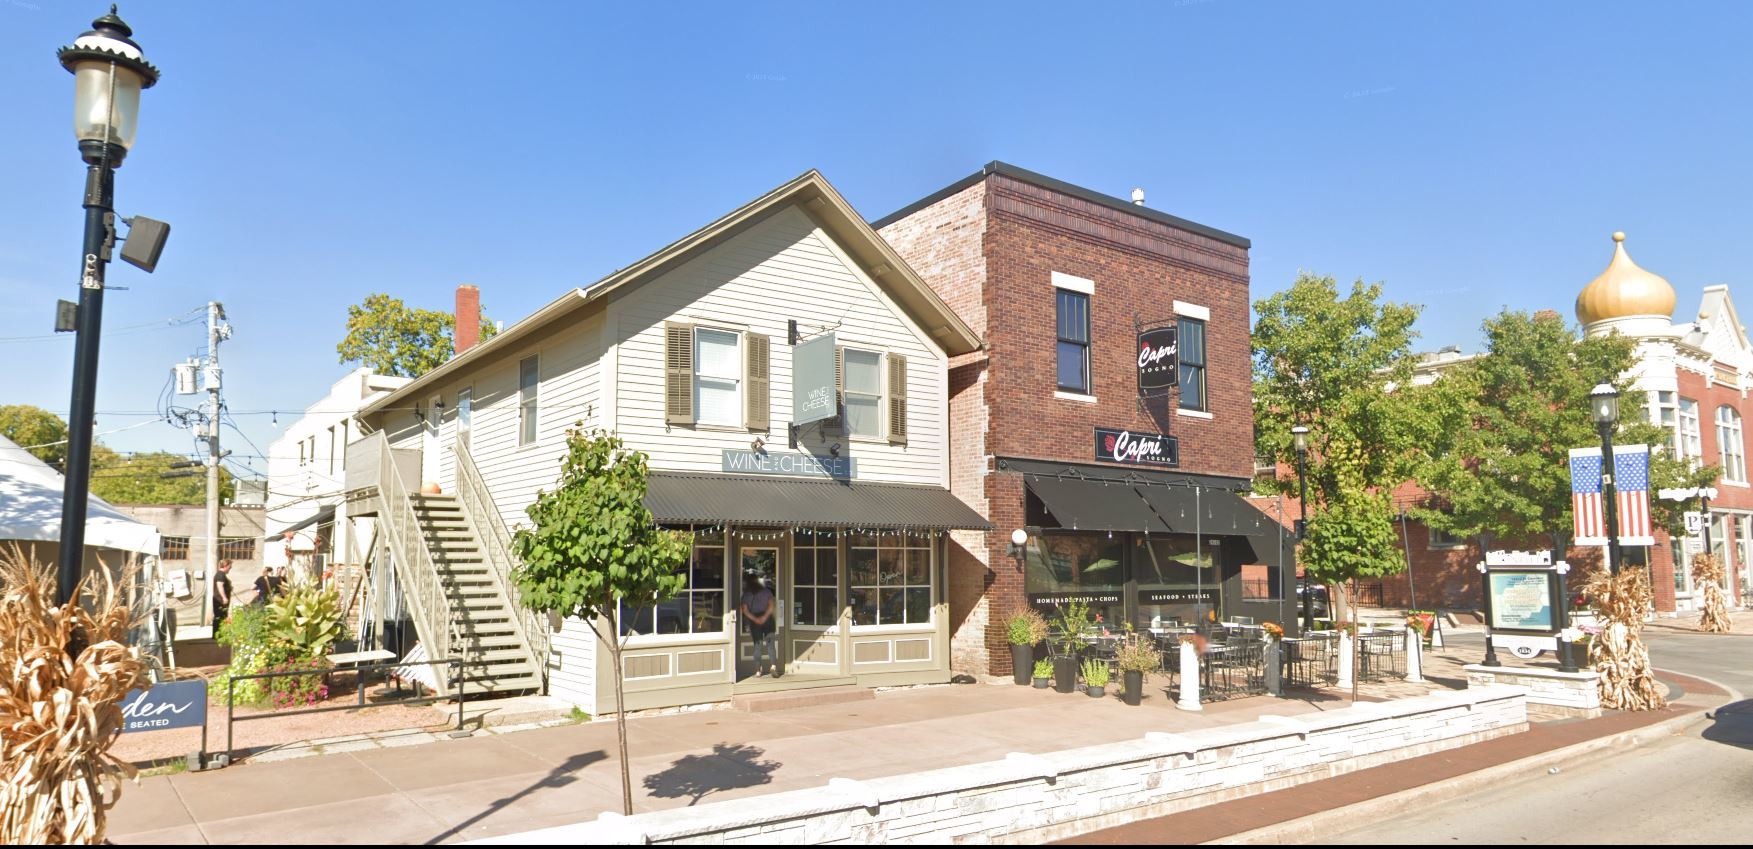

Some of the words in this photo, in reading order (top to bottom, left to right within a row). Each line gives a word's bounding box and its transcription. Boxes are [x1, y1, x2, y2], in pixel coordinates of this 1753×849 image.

[1138, 340, 1176, 367] Capri
[1141, 364, 1174, 373] SOGNO
[807, 386, 827, 400] WINE
[802, 395, 829, 411] CHEESE
[1113, 431, 1162, 462] Capri
[726, 452, 772, 471] WINE
[780, 455, 843, 475] CHEESE
[1688, 516, 1698, 528] P
[130, 719, 169, 728] SEATED
